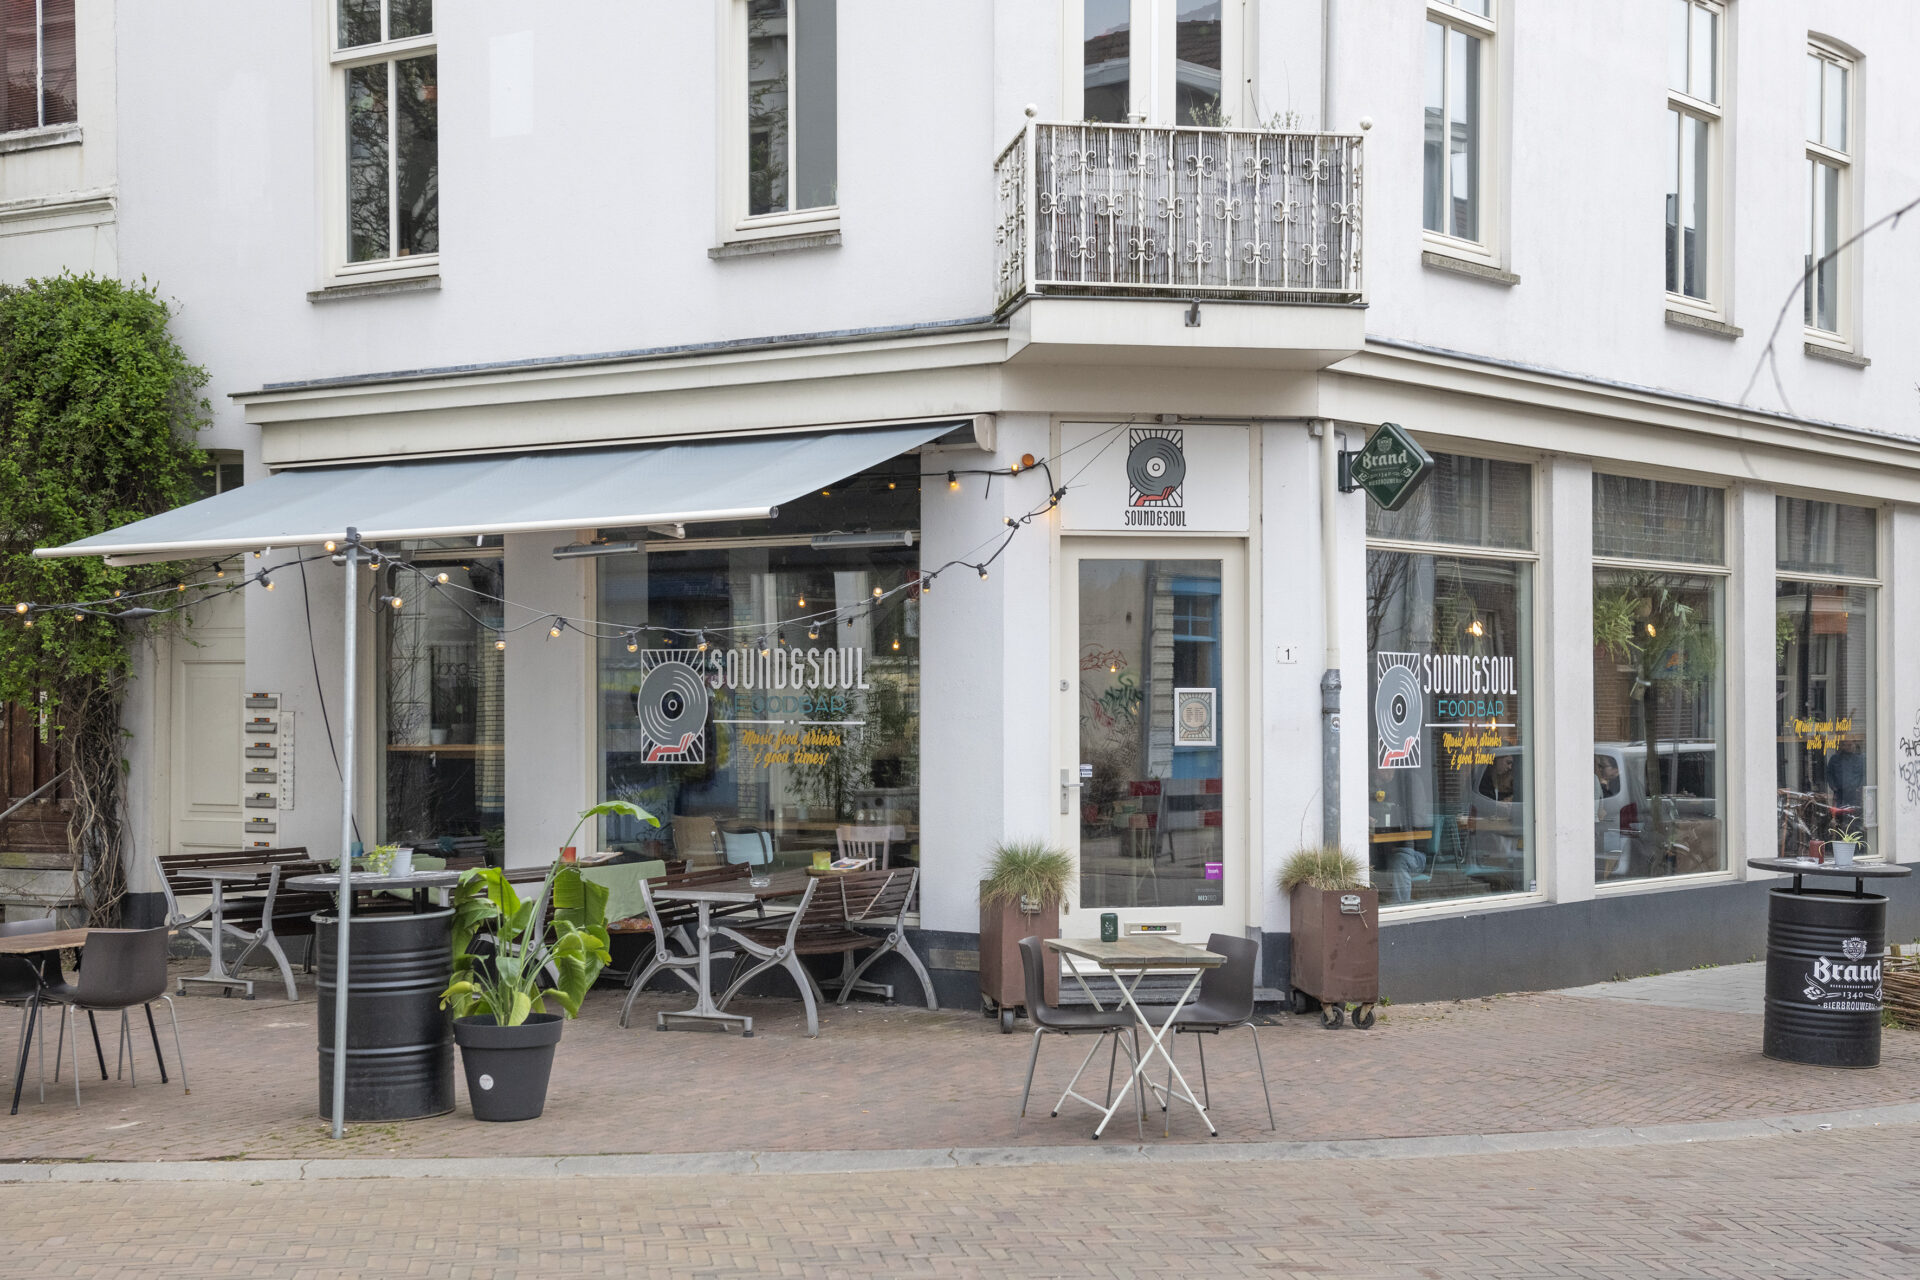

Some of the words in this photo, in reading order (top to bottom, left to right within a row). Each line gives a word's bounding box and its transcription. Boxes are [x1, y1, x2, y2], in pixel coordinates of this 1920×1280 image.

[1362, 449, 1408, 469] Brand
[1124, 510, 1187, 527] SOUND&SOUL
[1285, 648, 1290, 661] 1
[710, 646, 870, 690] SOUND&SOUL
[1423, 653, 1518, 695] SOUND&SOUL
[734, 695, 847, 714] FOODBAR
[1438, 700, 1505, 717] FOODBAR
[801, 728, 842, 747] drinks
[1480, 730, 1502, 748] drinks
[763, 748, 790, 769] good
[793, 744, 830, 766] times!
[1457, 752, 1473, 771] good
[1475, 749, 1496, 766] times!
[1813, 956, 1882, 984] Brand
[1842, 991, 1864, 1000] 1340
